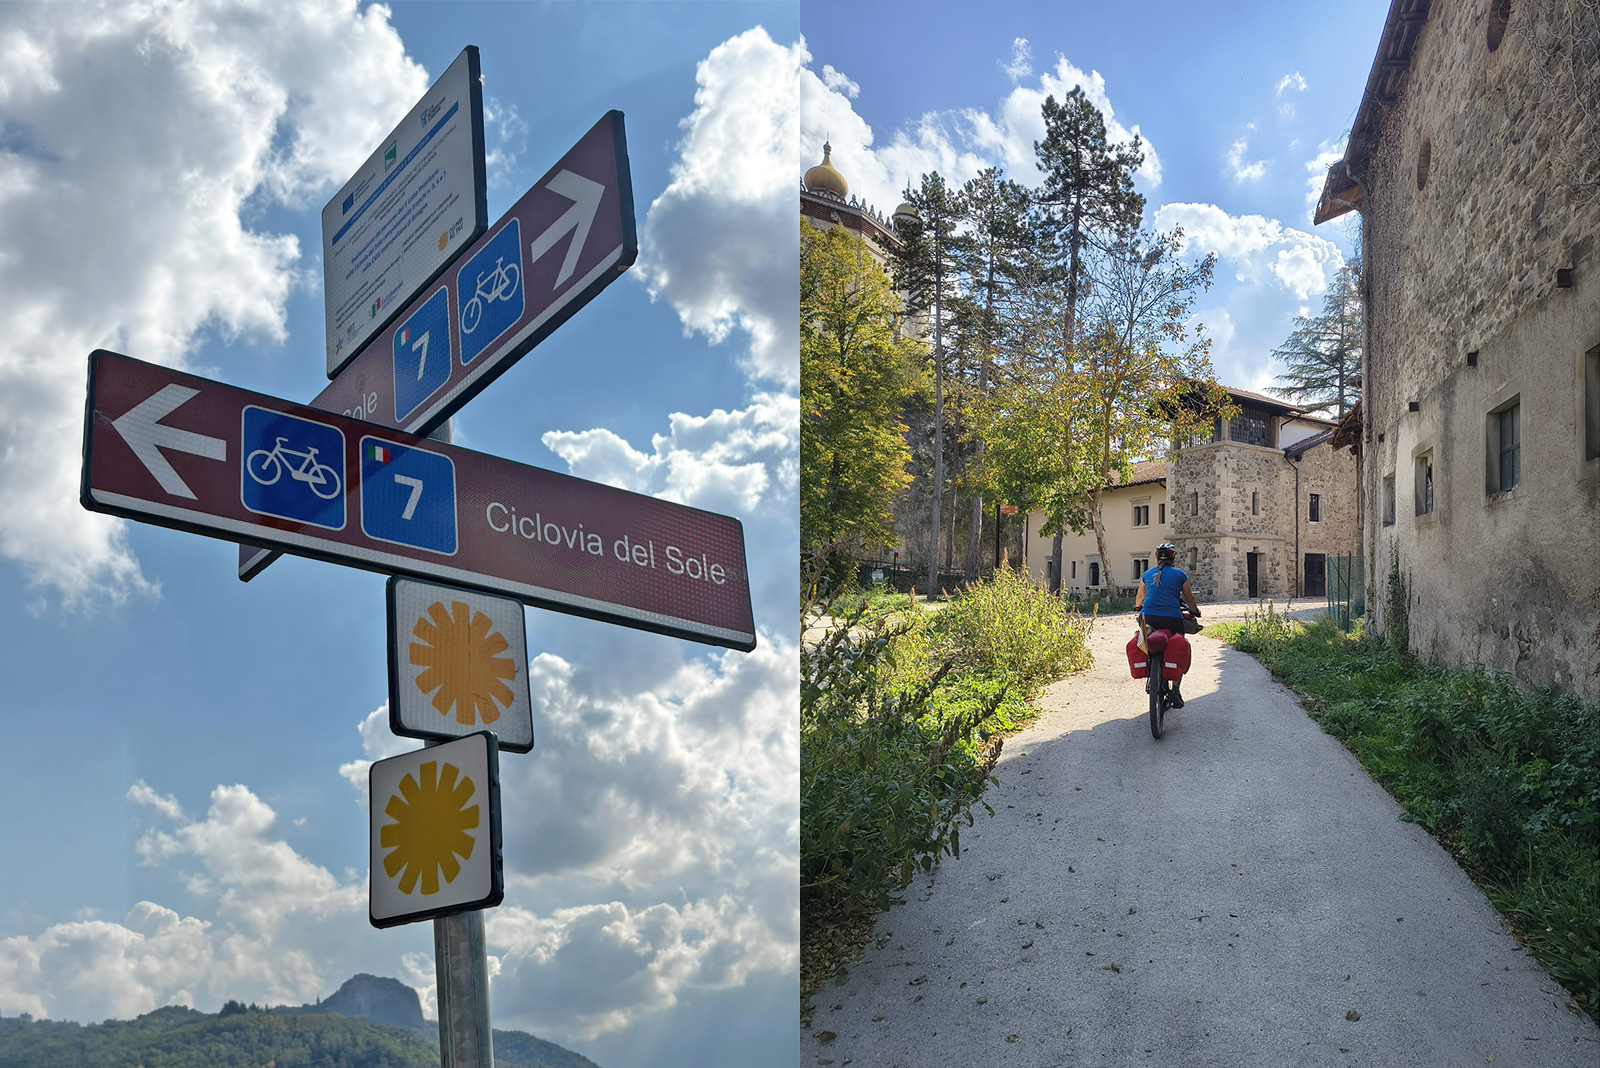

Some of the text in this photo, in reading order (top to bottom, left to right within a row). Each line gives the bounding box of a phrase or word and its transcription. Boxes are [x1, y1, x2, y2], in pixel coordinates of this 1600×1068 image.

[411, 330, 430, 381] 7
[394, 473, 424, 521] 7
[486, 501, 726, 585] Ciclovia del Sole
